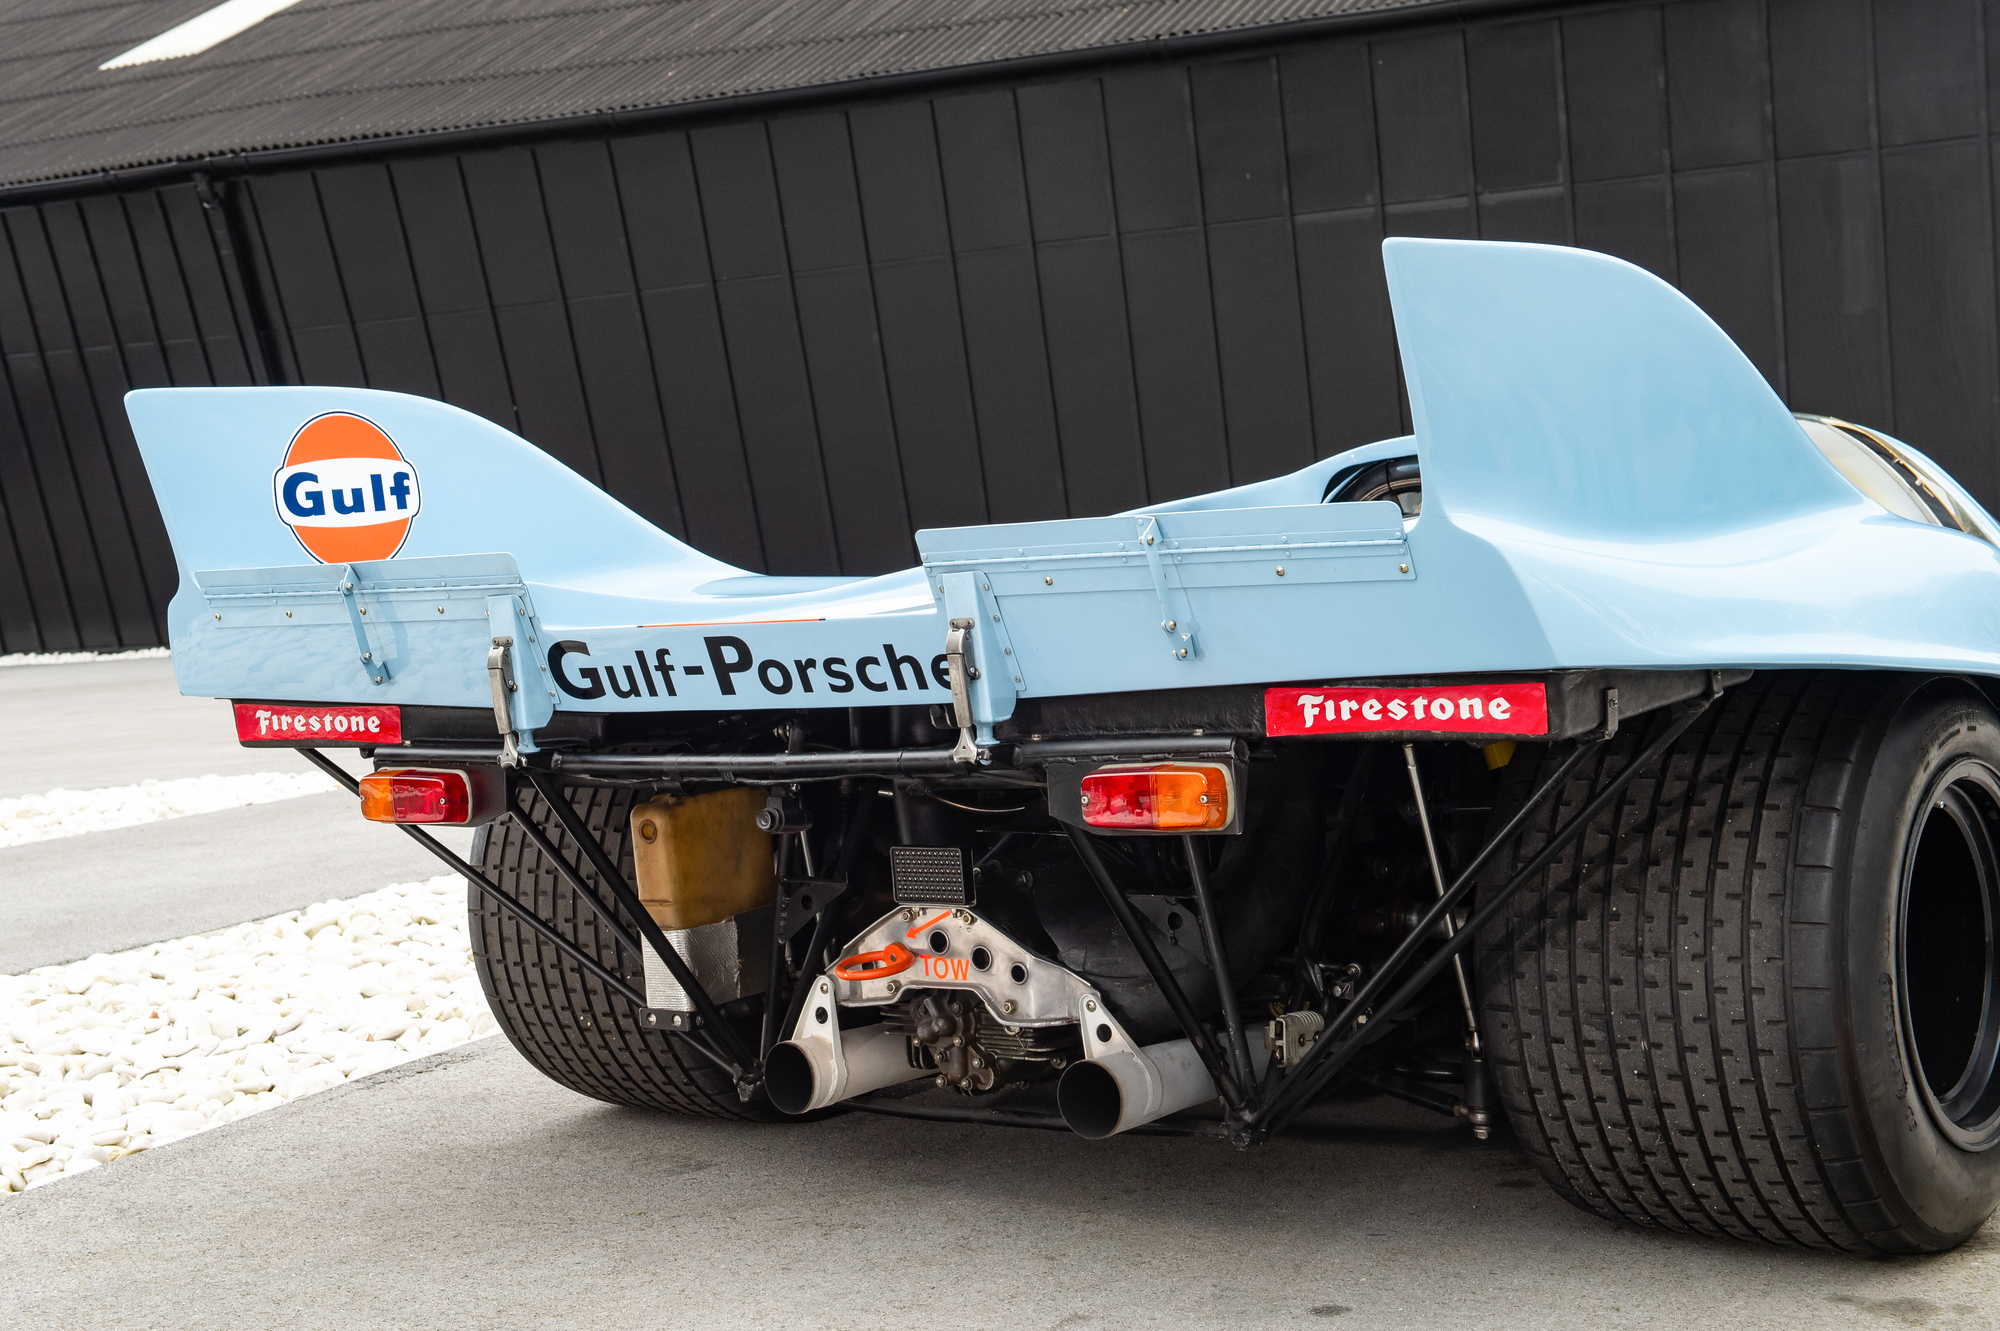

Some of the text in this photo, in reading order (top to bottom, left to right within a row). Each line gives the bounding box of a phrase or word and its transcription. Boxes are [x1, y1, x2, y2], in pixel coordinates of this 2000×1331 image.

[283, 472, 411, 517] Gulf
[548, 637, 951, 700] Gulf-Porsche
[256, 710, 380, 735] Firestone
[1298, 694, 1511, 728] Firestone
[919, 955, 970, 981] TOW
